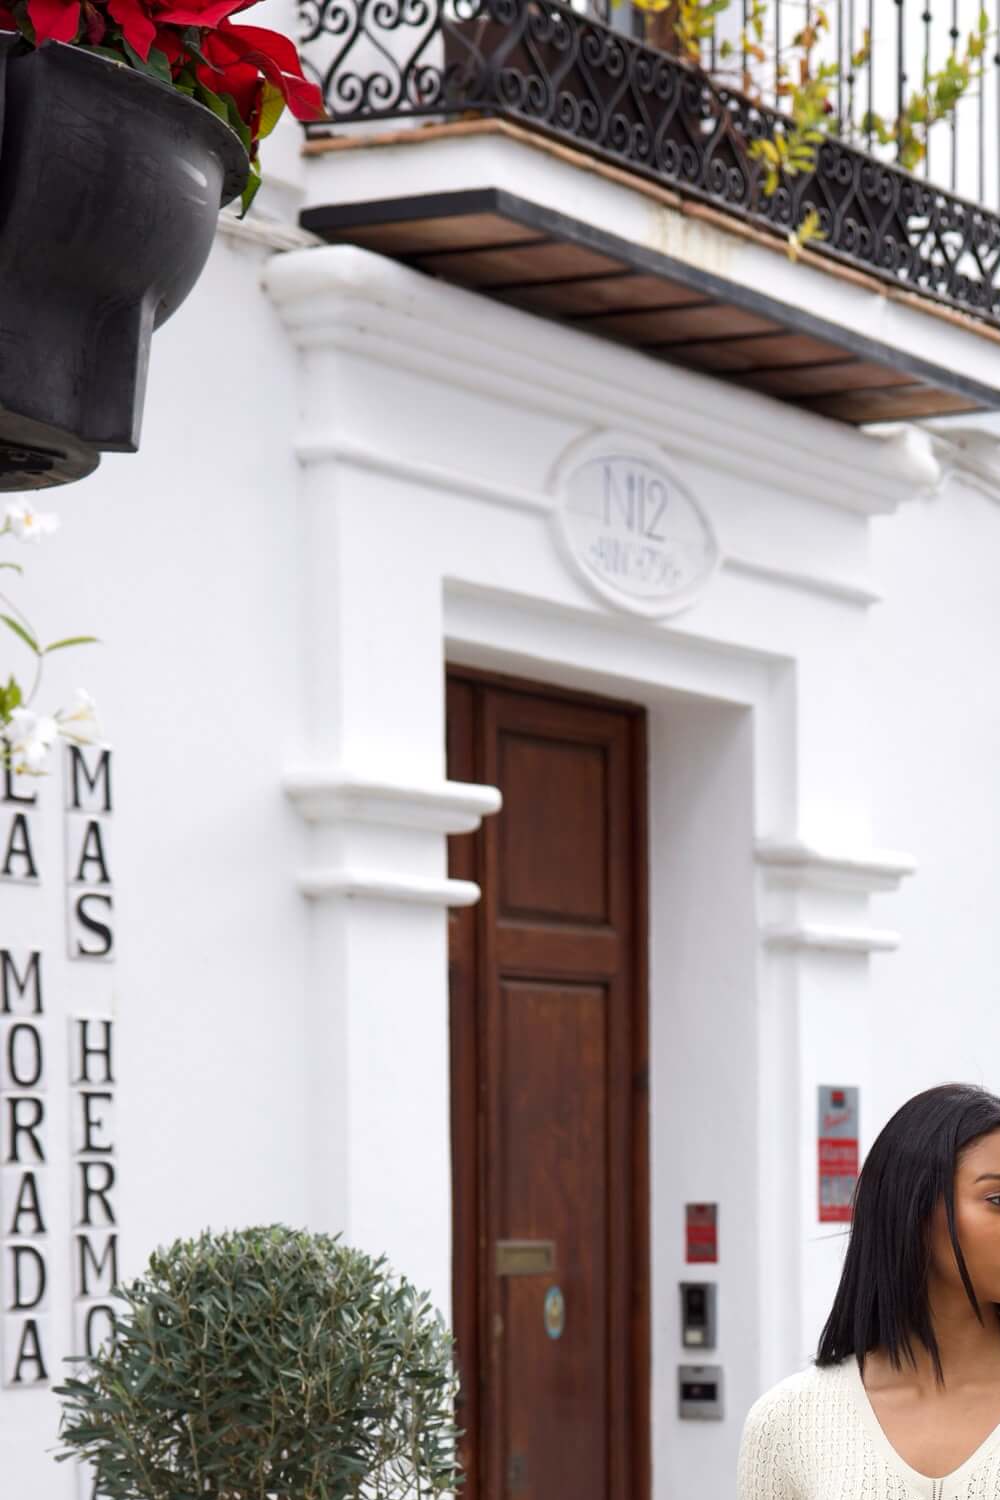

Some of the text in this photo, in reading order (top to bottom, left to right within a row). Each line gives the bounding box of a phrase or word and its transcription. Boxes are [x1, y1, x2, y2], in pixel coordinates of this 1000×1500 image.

[0, 736, 48, 1383] LA MORADA
[68, 745, 113, 956] MAS
